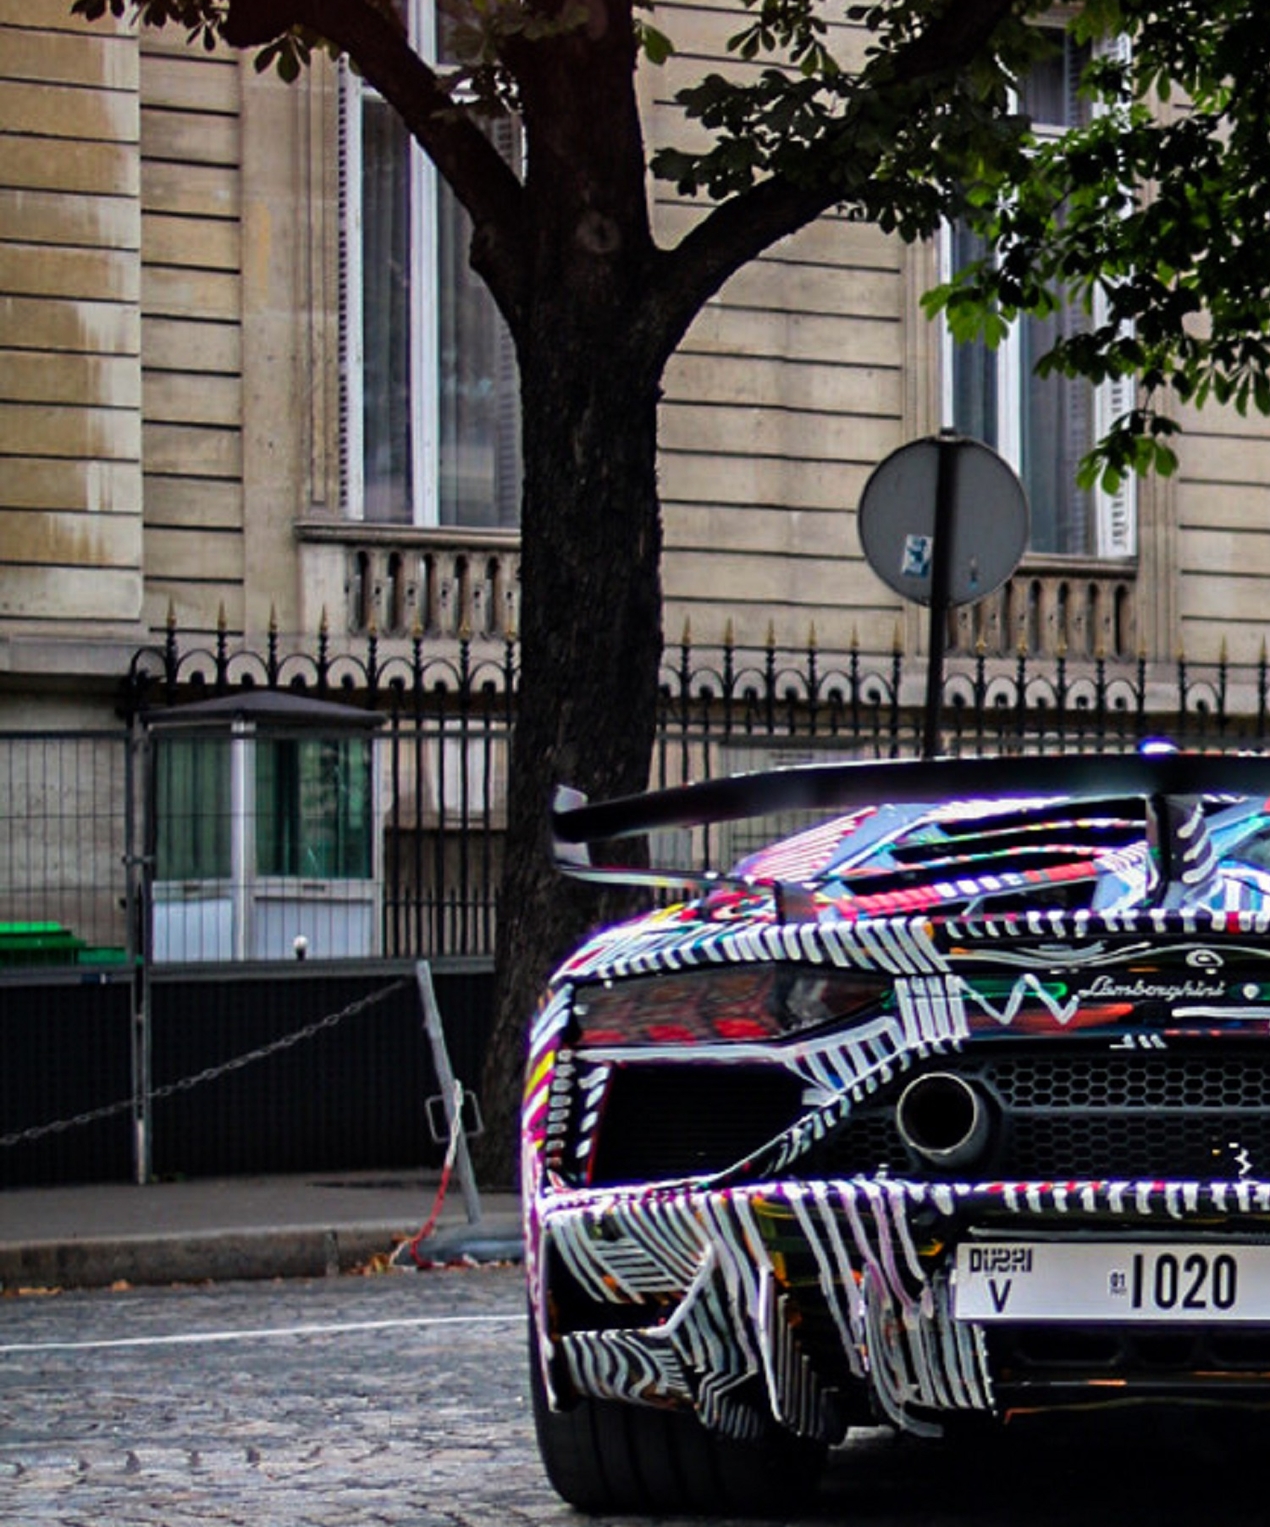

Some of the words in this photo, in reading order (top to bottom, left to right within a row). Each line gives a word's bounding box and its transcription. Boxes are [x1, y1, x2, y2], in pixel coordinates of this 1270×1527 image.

[1077, 975, 1226, 1002] Lamborghini
[988, 1278, 1012, 1313] V
[1131, 1253, 1238, 1310] 1020
